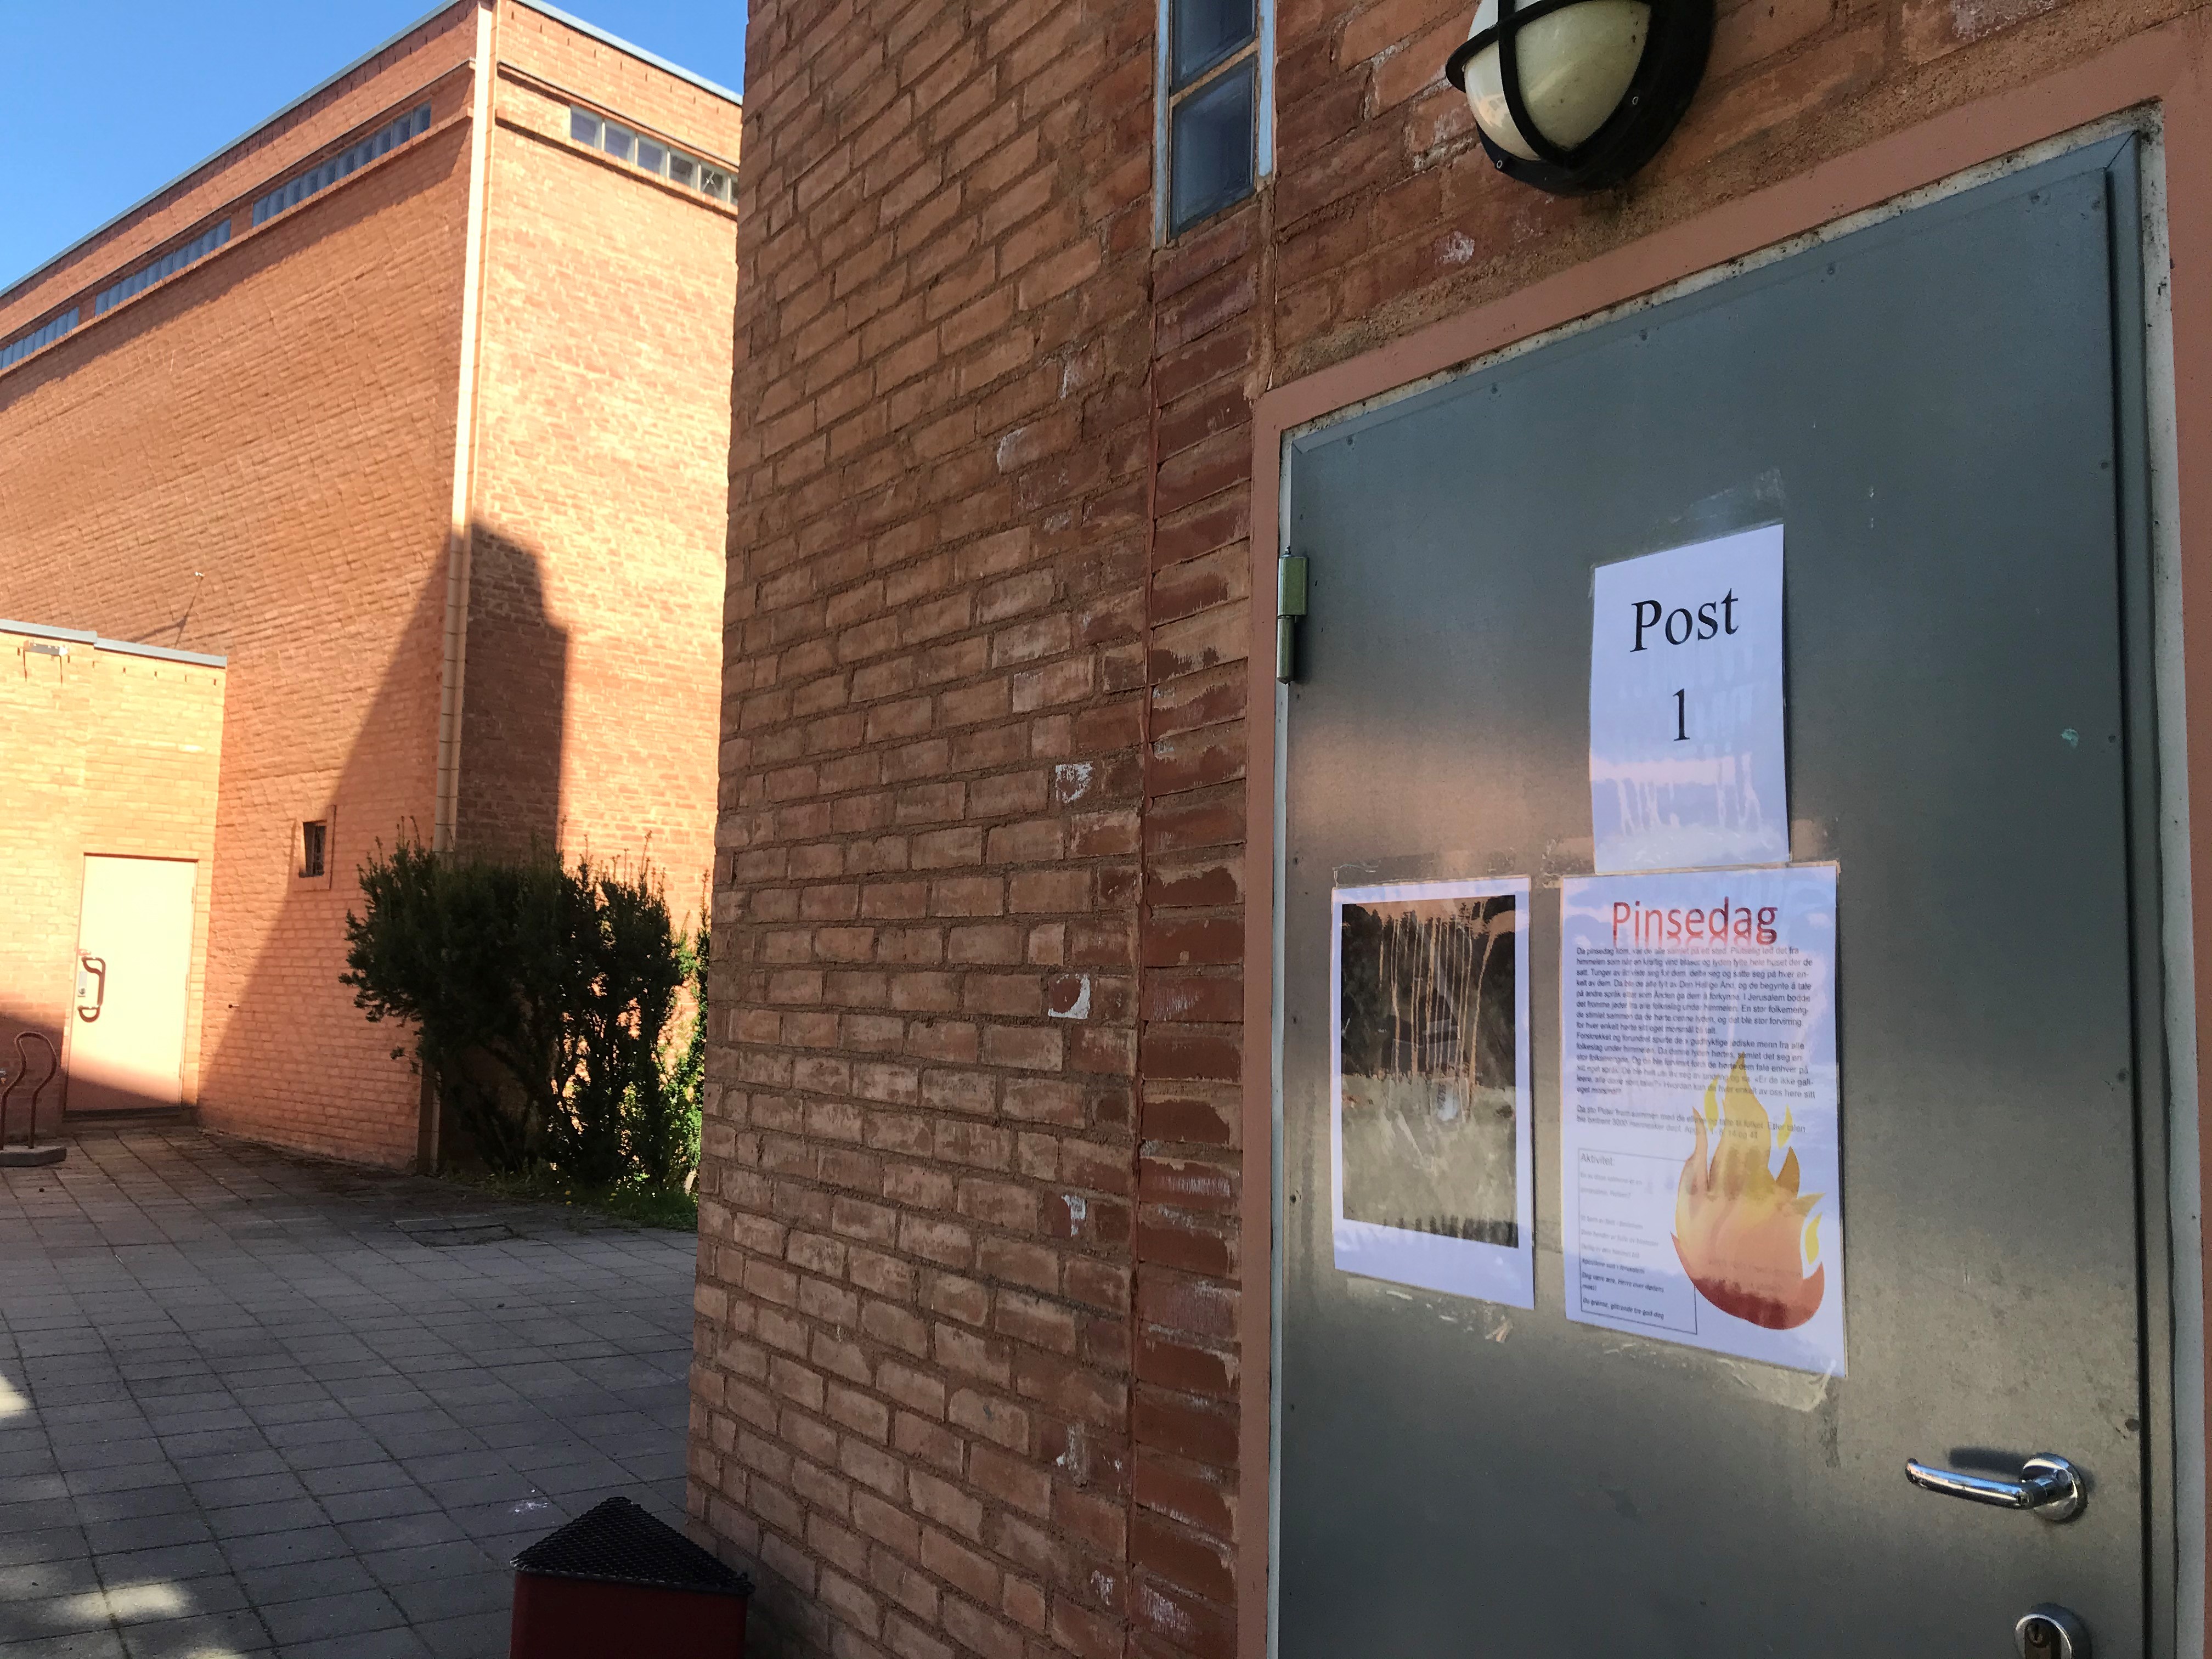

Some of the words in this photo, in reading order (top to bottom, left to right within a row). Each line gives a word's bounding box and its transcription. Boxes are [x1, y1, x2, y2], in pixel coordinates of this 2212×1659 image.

[1630, 588, 1739, 653] Post
[1672, 688, 1691, 741] 1
[1613, 896, 1778, 945] Pinsedag
[1767, 970, 1776, 979] på
[1748, 993, 1785, 1001] Jerusalem
[1787, 994, 1810, 1002] bodde
[1763, 1052, 1774, 1060] det
[1776, 1054, 1790, 1063] seg
